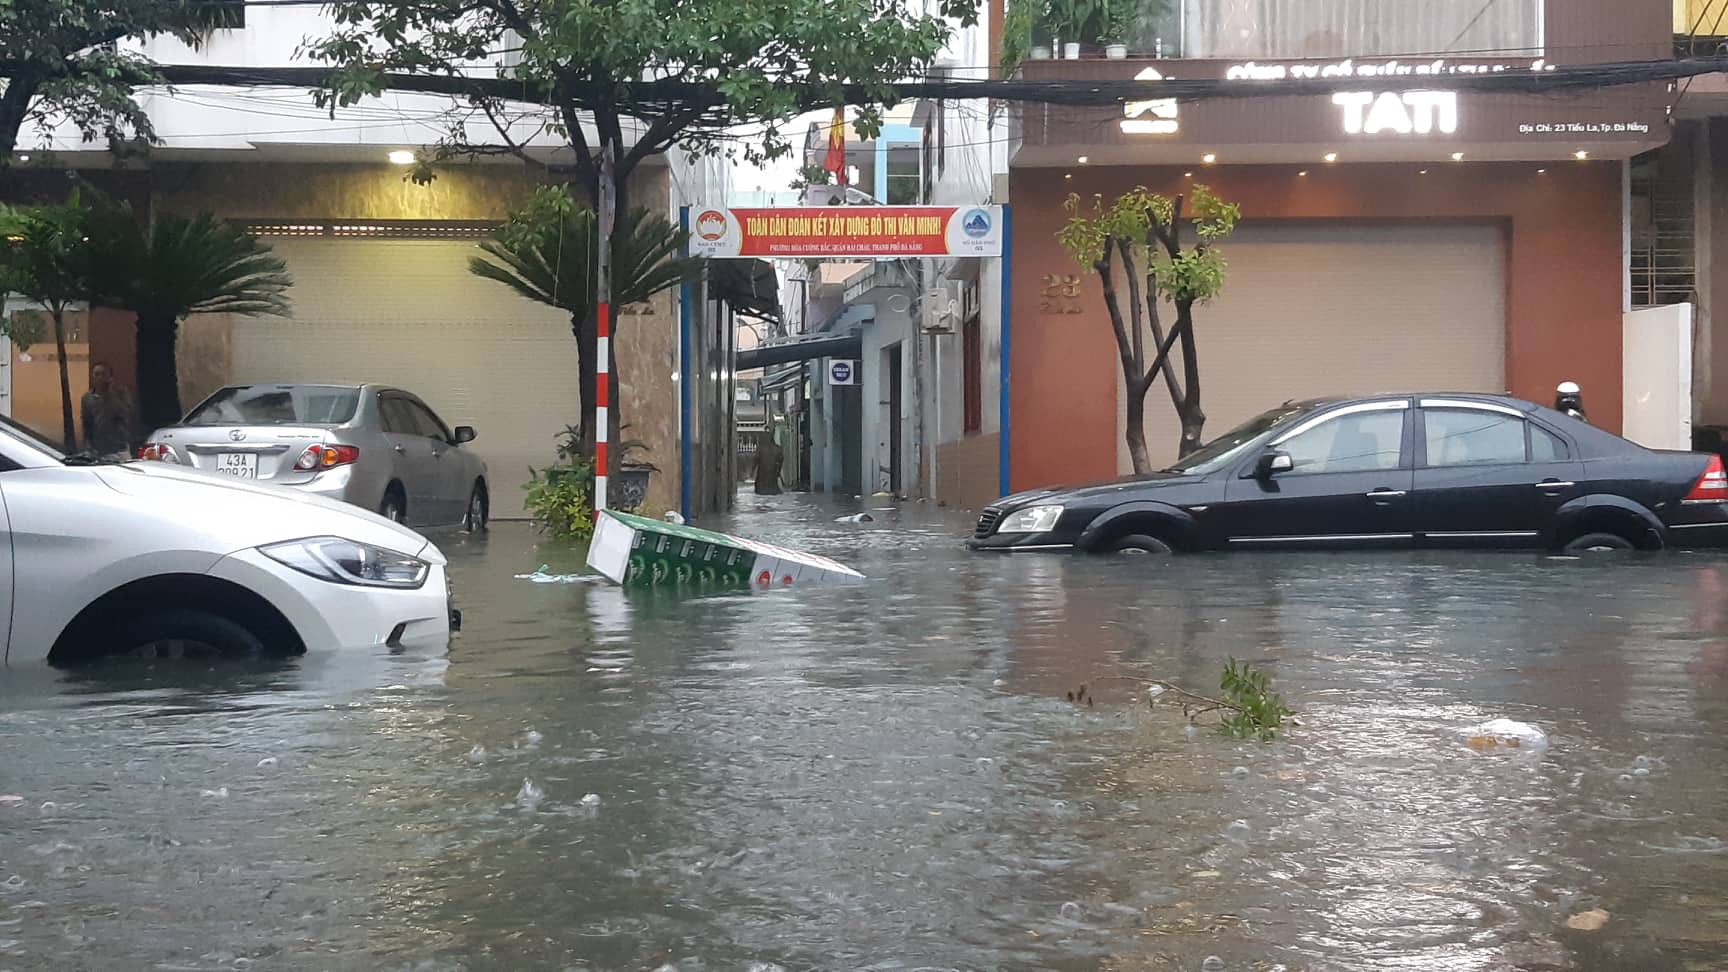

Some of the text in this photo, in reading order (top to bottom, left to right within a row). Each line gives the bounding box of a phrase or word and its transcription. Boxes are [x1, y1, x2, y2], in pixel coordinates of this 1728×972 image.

[1331, 90, 1457, 134] TATI
[1519, 124, 1533, 134] Địa
[1554, 124, 1566, 132] 23
[746, 211, 941, 240] TOÀN DÂN ĐOÀN KẾT XÂY DỰNG ĐÔ THỊ VĂN MINH!
[226, 454, 247, 466] 43A
